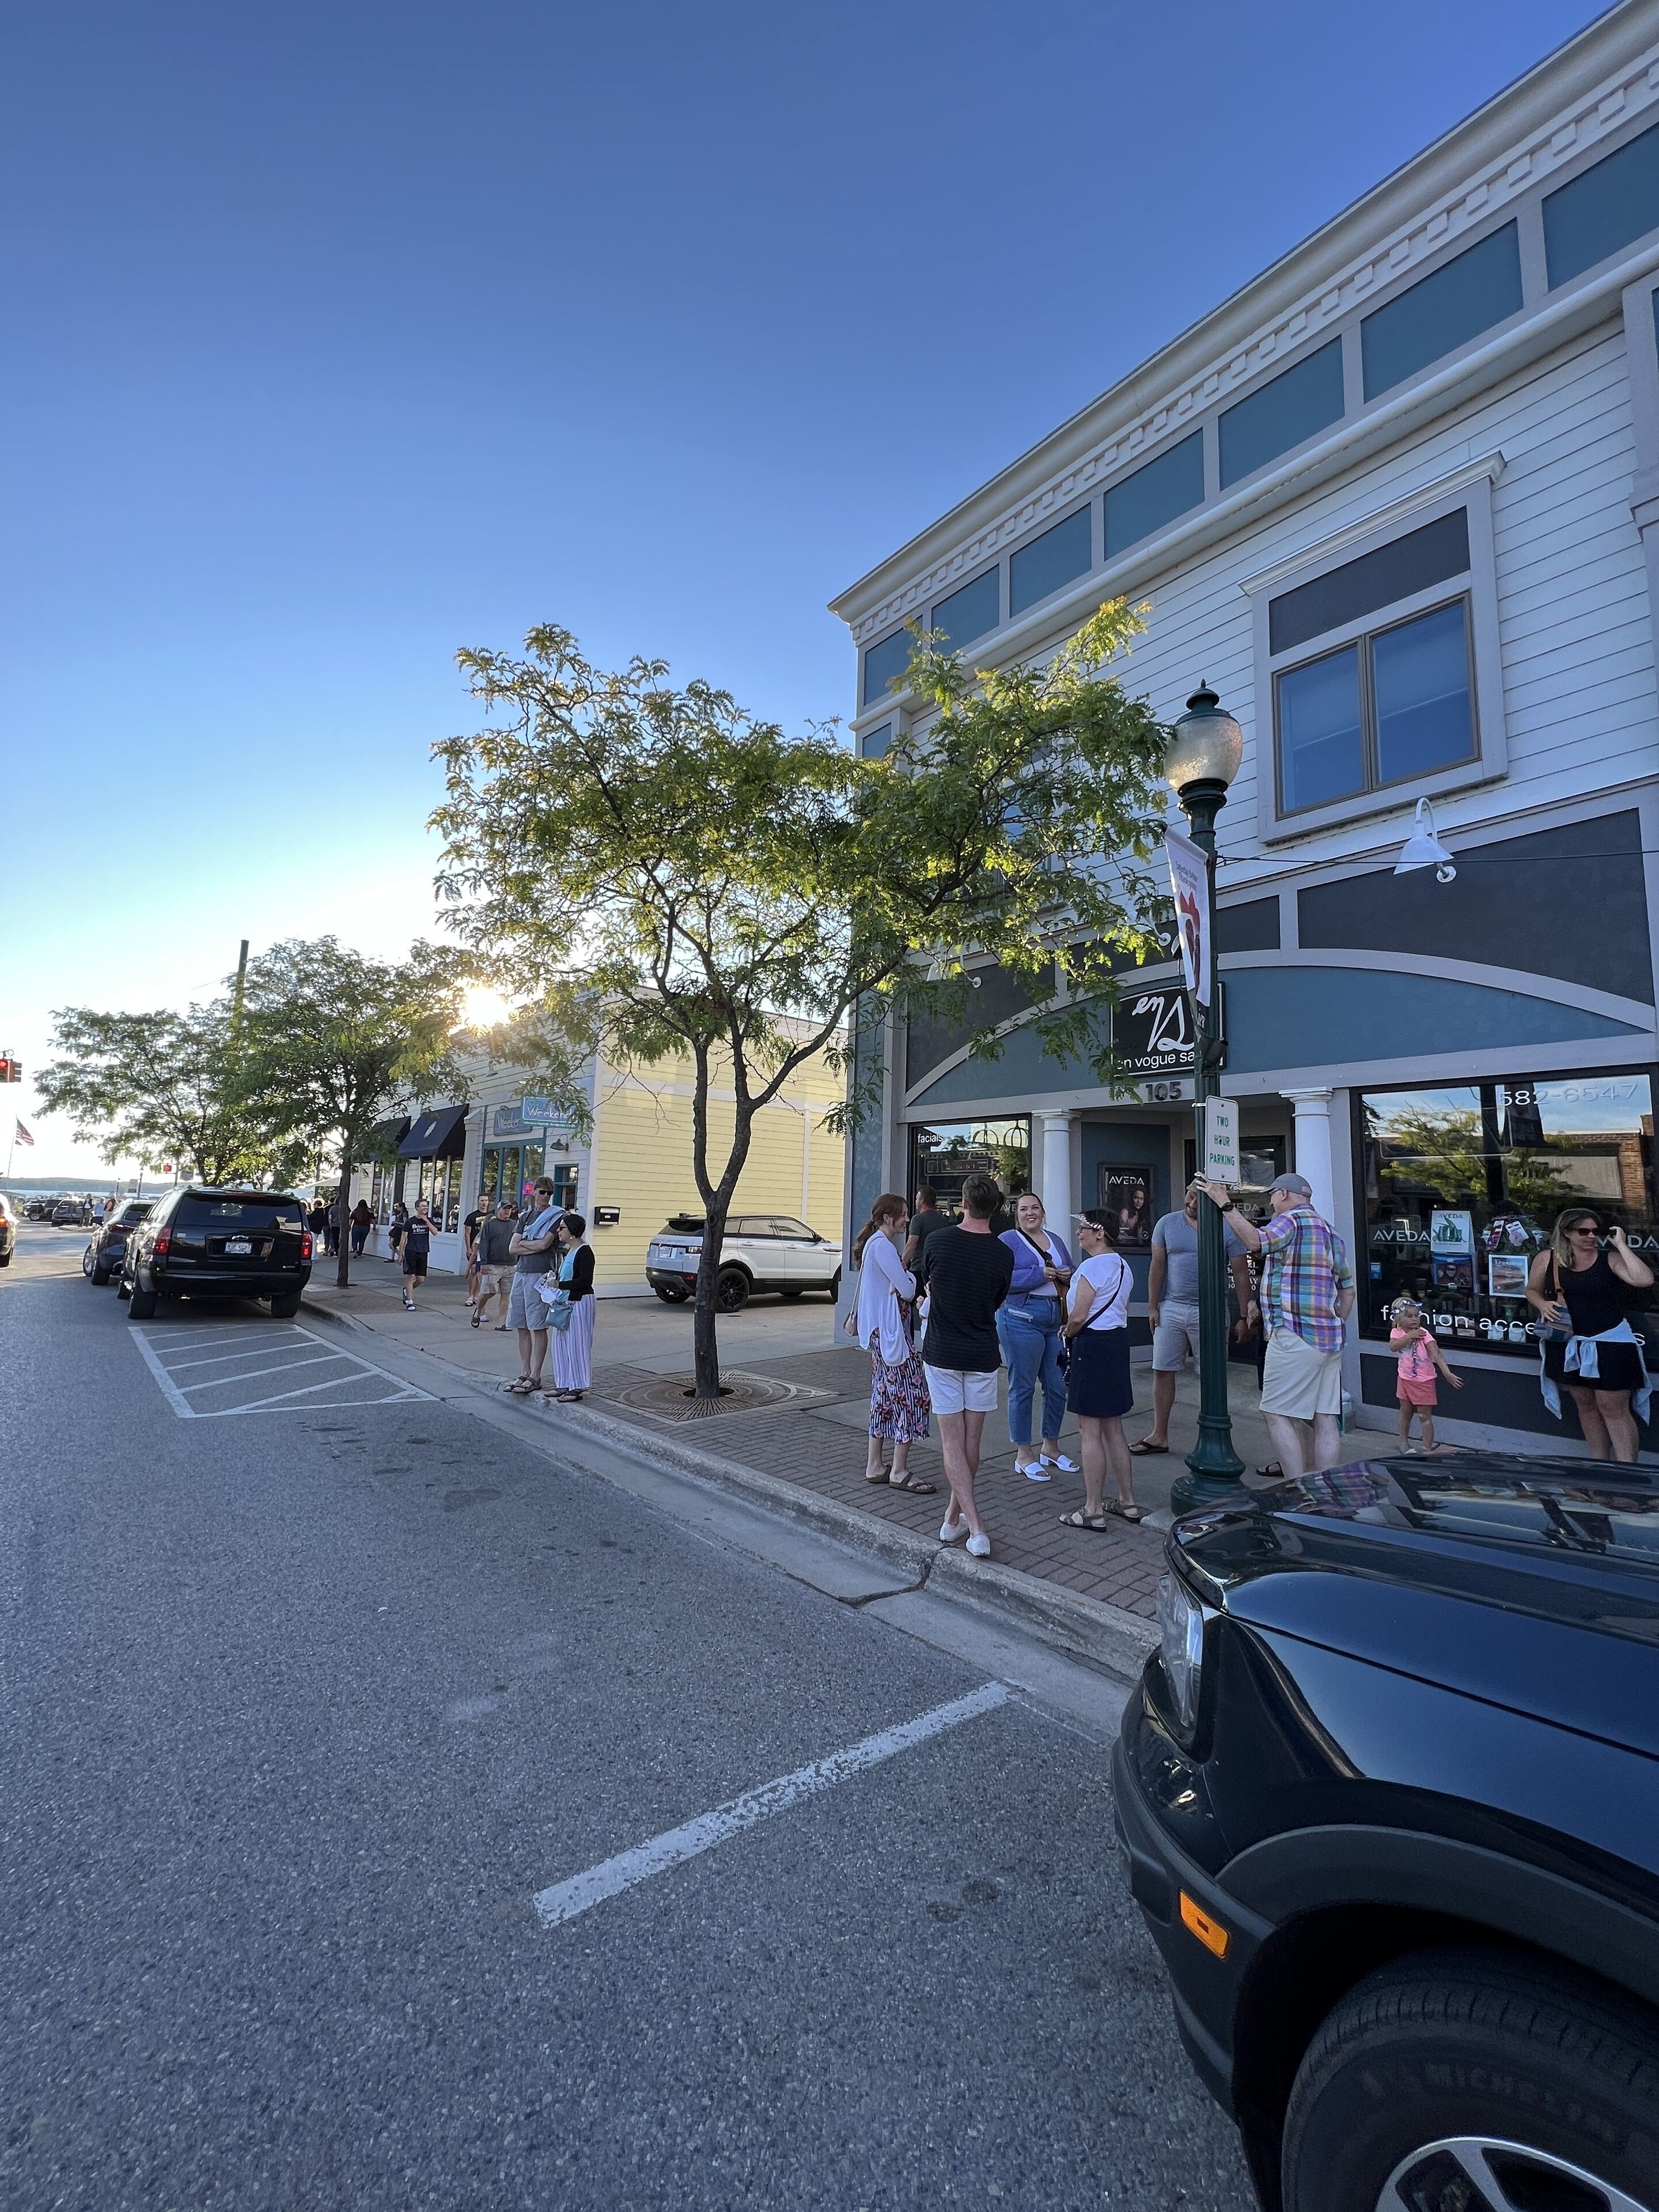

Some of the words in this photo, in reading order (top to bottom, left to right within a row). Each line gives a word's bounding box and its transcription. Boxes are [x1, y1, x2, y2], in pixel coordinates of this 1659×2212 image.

[1135, 1053, 1176, 1069] vogue
[1146, 1081, 1182, 1101] 105
[1499, 1083, 1638, 1107] 582-6547
[527, 1105, 573, 1119] Weekend
[1216, 1115, 1229, 1127] TWO
[917, 1133, 944, 1143] facials
[1214, 1134, 1230, 1147] HOUR
[1210, 1153, 1235, 1166] PARKING
[1109, 1176, 1145, 1185] AVEDA
[1373, 1230, 1431, 1242] AVEDA
